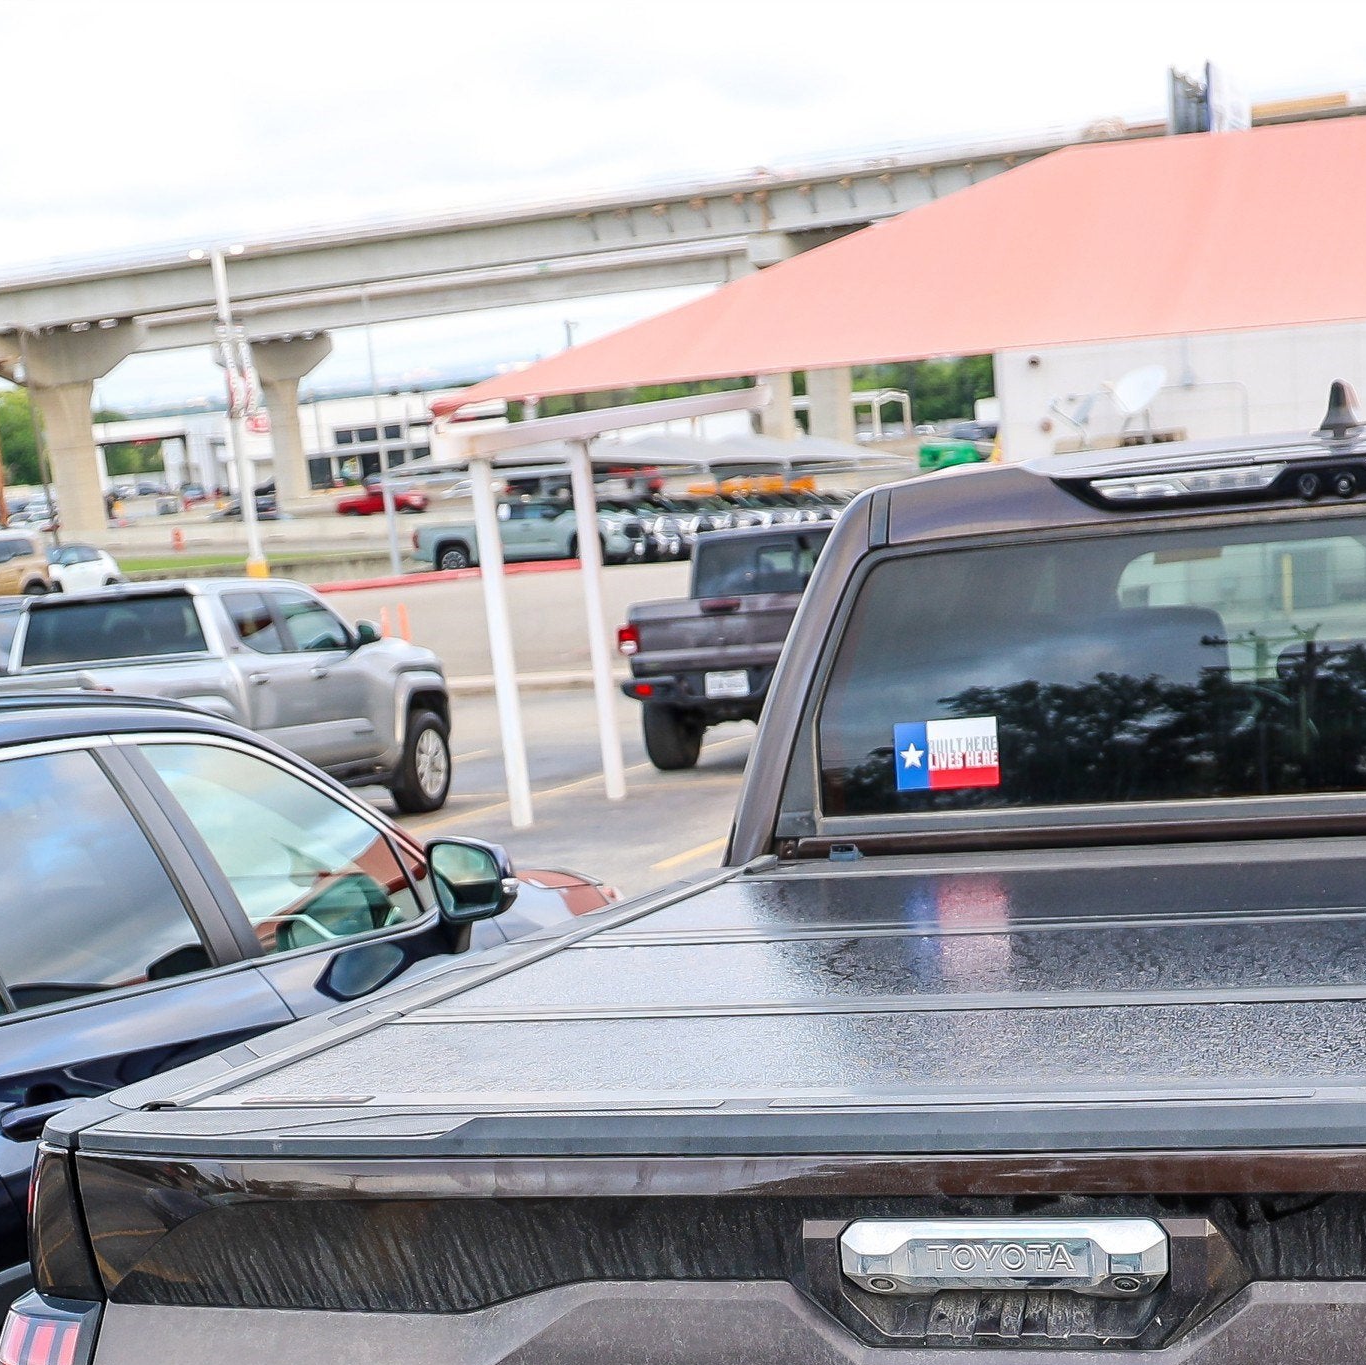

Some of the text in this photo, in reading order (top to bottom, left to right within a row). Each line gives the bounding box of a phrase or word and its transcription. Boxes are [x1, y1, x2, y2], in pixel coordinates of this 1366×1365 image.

[965, 735, 998, 752] HERE
[929, 749, 998, 770] LIVES HERE
[926, 1243, 1077, 1273] TOYOTA
